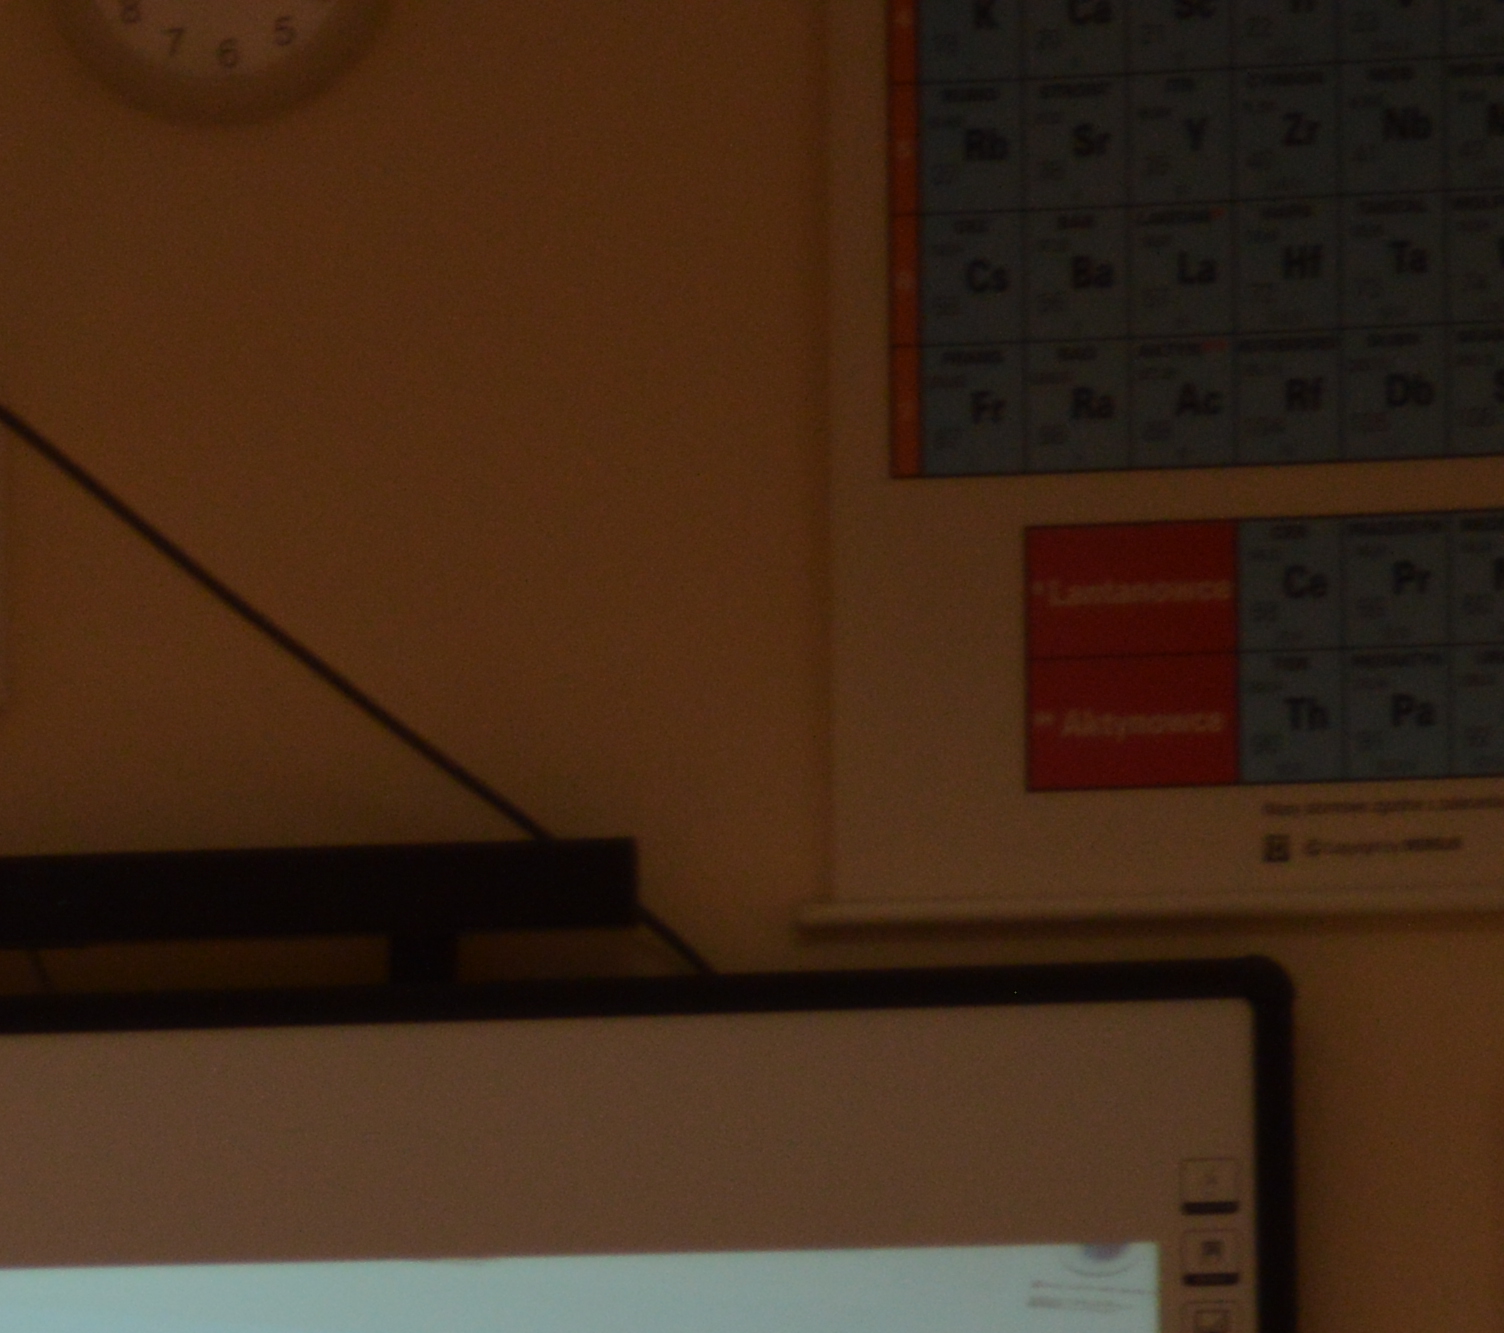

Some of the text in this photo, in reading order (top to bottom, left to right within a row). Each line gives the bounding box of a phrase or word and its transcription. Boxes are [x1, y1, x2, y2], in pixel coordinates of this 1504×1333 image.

[163, 28, 185, 55] 7
[274, 16, 297, 46] 5
[216, 38, 238, 70] 6
[1070, 122, 1111, 157] Sr
[1182, 115, 1207, 150] Y
[1281, 112, 1319, 148] Zr
[1381, 105, 1434, 143] Nb
[962, 126, 1011, 163] Rb
[1069, 254, 1114, 290] Ba
[1176, 251, 1218, 286] La
[1282, 243, 1325, 281] Hf
[1388, 239, 1428, 275] Ta
[964, 258, 1011, 294] Cs
[970, 391, 1006, 425] Fr
[1070, 386, 1114, 419] Ra
[1176, 381, 1223, 418] Ac
[1285, 376, 1325, 413] Rf
[1385, 372, 1436, 409] Db
[1281, 564, 1329, 600] Ce
[1392, 559, 1431, 594] Pr
[1283, 696, 1329, 731] Th
[1389, 693, 1437, 729] Pa
